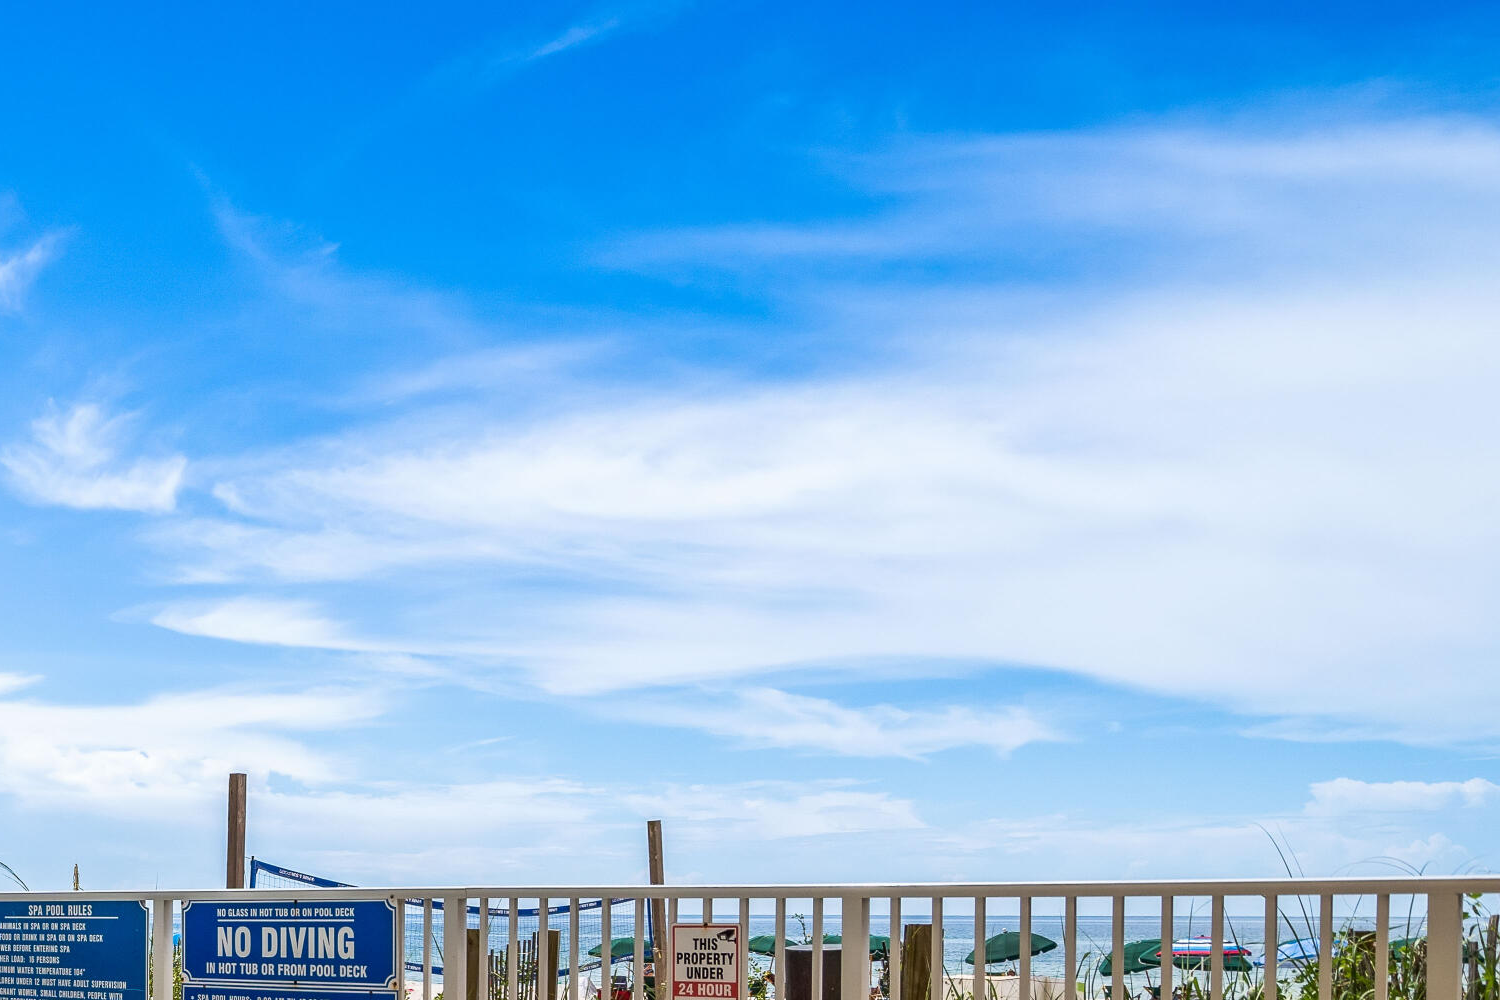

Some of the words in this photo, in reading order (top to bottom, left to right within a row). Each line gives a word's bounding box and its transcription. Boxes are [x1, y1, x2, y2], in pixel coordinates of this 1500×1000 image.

[28, 905, 42, 915] SPA
[46, 905, 65, 916] POOL
[68, 905, 92, 916] RULES
[217, 908, 226, 916] NO
[228, 908, 248, 916] GLASS
[251, 908, 257, 916] IN
[259, 908, 272, 916] HOT
[275, 908, 288, 916] TUB
[291, 908, 300, 916] OR
[302, 908, 312, 916] ON
[314, 908, 333, 916] POOL
[335, 908, 354, 916] DECK
[217, 926, 251, 957] NO
[262, 926, 355, 959] DIVING
[693, 938, 717, 950] THIS
[677, 952, 734, 965] PROPERTY
[36, 967, 72, 975] TEMPERATURE
[206, 962, 215, 974] IN
[218, 962, 236, 974] HOT
[240, 963, 258, 975] TUB
[261, 964, 274, 975] OR
[278, 964, 306, 976] FROM
[310, 965, 336, 977] POOL
[340, 965, 367, 977] DECK
[687, 967, 723, 979] UNDER
[92, 981, 126, 989] SUPERVISION
[679, 984, 693, 995] 24
[698, 984, 732, 996] HOUR
